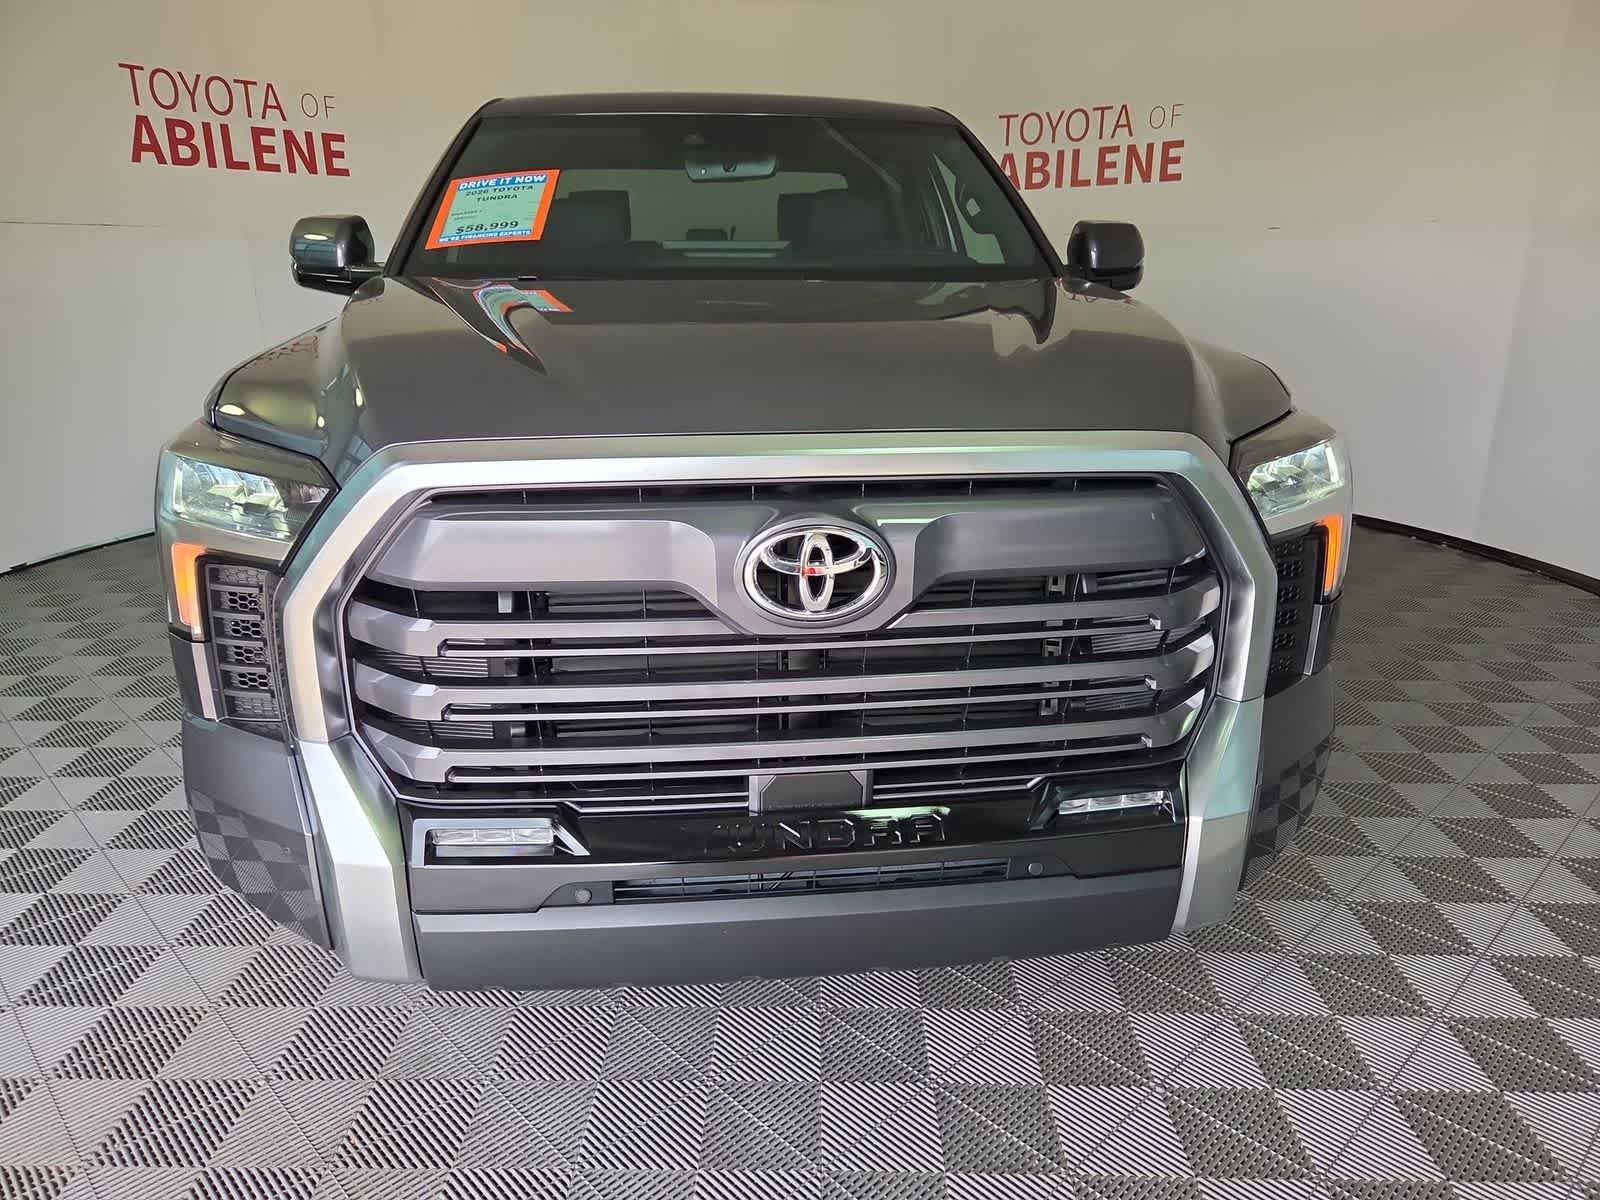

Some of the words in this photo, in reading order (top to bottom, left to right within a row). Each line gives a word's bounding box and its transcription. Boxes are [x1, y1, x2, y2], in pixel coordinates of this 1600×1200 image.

[118, 63, 287, 121] TOYOTA
[300, 93, 335, 120] OF
[131, 114, 351, 177] ABILENE
[998, 103, 1134, 146] TOYOTA
[1149, 103, 1185, 130] OF
[459, 180, 498, 190] DRIVE
[499, 177, 513, 185] IT
[514, 175, 546, 183] NOW
[998, 139, 1185, 191] ABILENE
[476, 193, 518, 202] TUNDRA
[493, 184, 534, 194] TOYOTA
